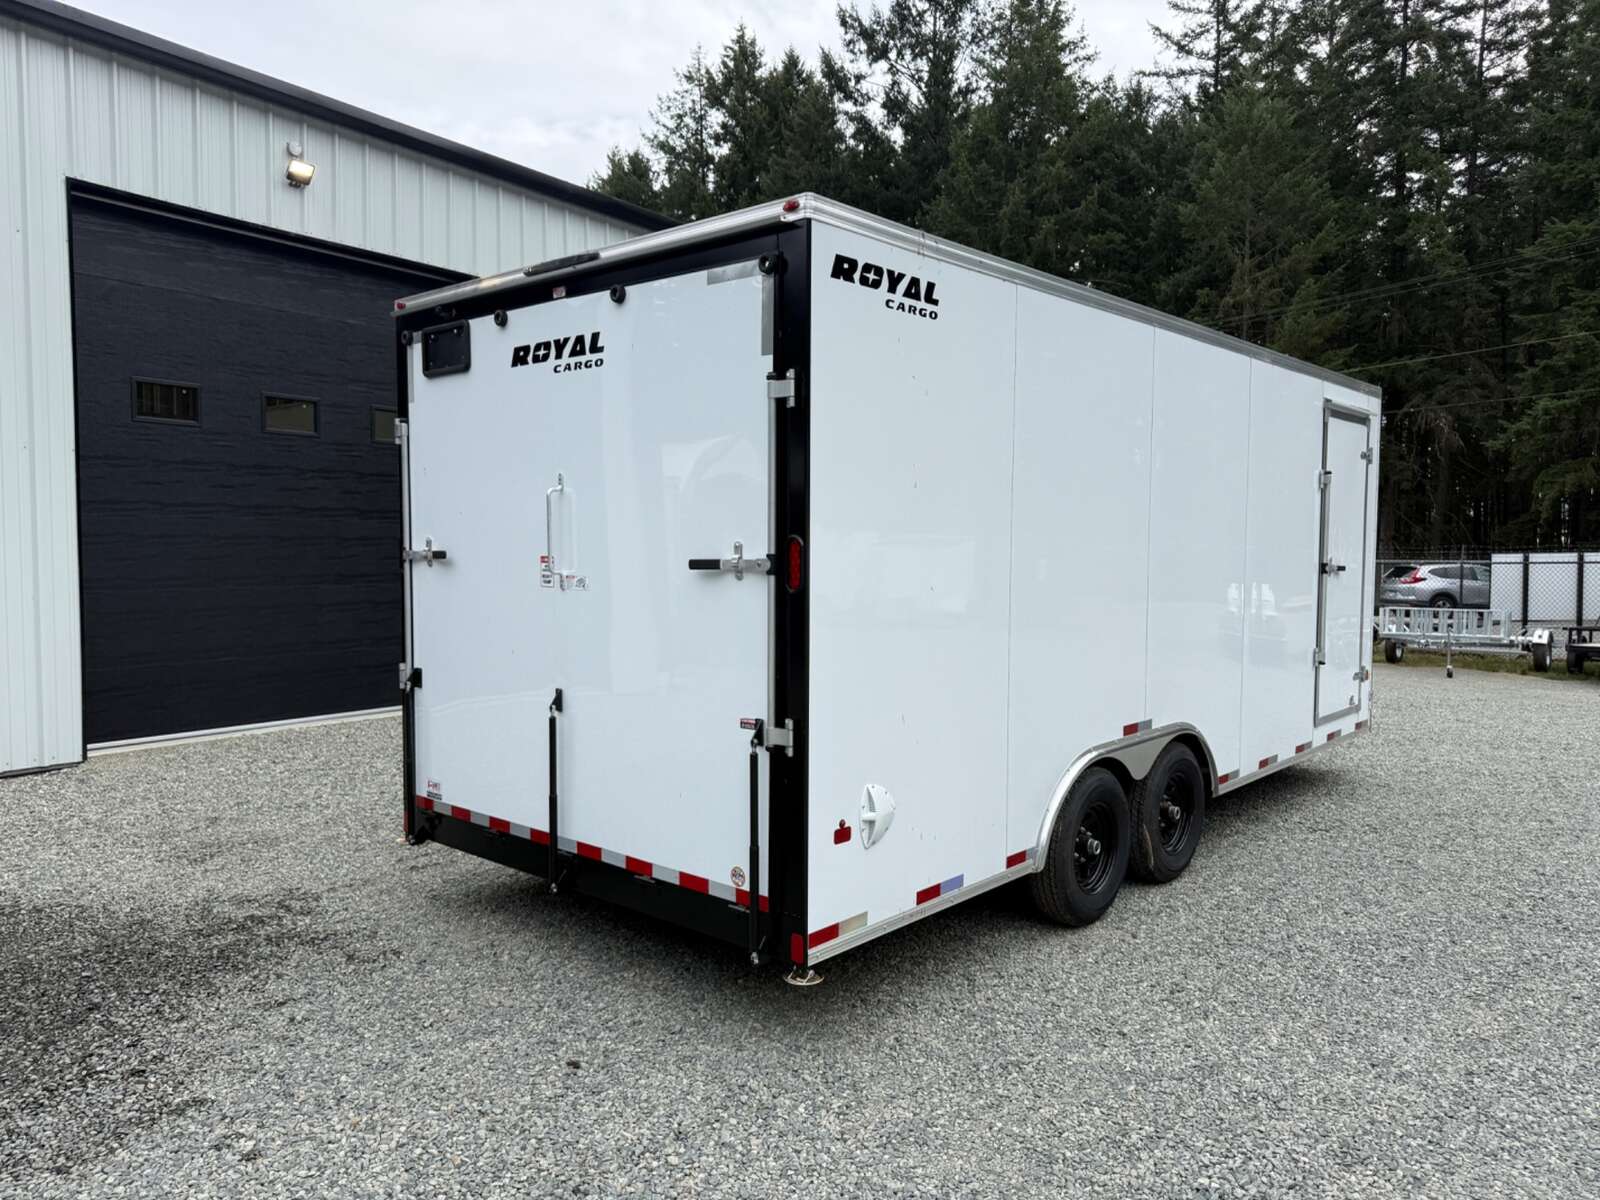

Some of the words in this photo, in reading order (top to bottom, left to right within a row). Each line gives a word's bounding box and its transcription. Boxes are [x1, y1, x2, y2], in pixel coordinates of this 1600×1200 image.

[830, 253, 939, 306] ROYAL
[885, 299, 938, 320] CARGO
[511, 331, 604, 368] ROYAL
[553, 358, 604, 373] CARGO
